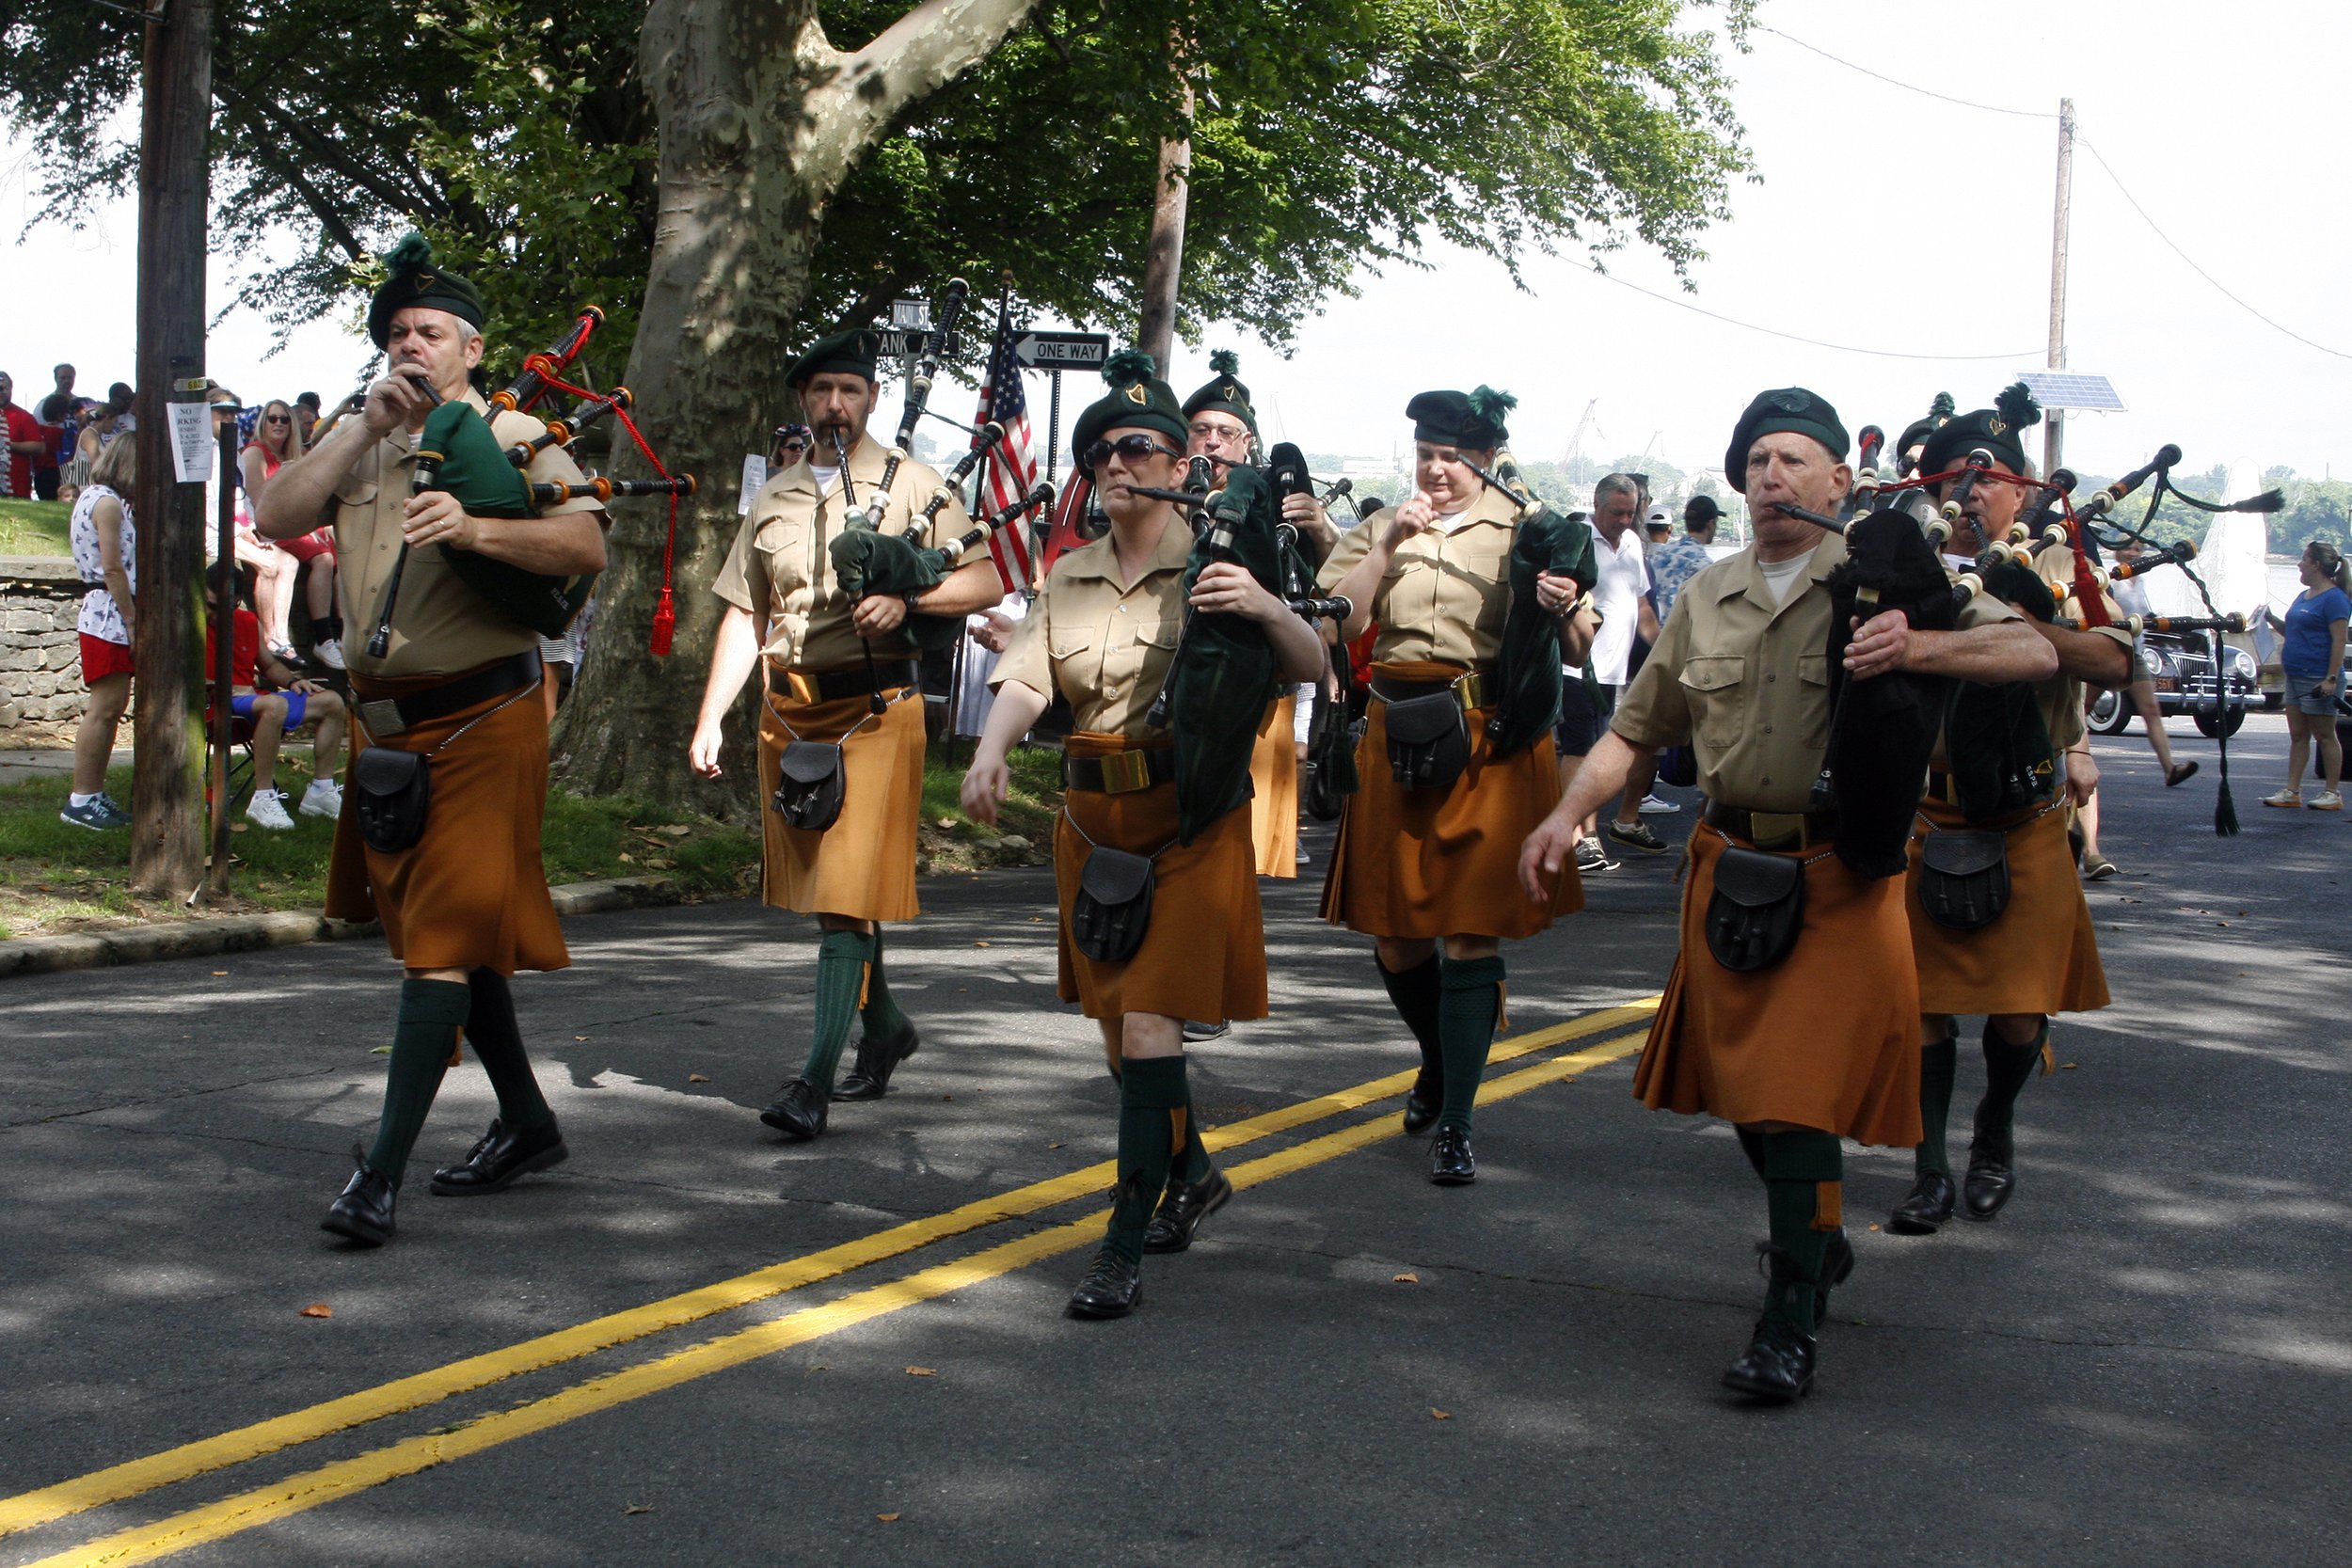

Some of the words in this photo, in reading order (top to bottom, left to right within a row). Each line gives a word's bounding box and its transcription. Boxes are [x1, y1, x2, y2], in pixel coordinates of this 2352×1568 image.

[894, 304, 914, 324] MAIN
[918, 306, 930, 325] ST
[875, 333, 909, 354] ANK
[1037, 343, 1065, 358] ONE
[1070, 344, 1099, 358] WAY
